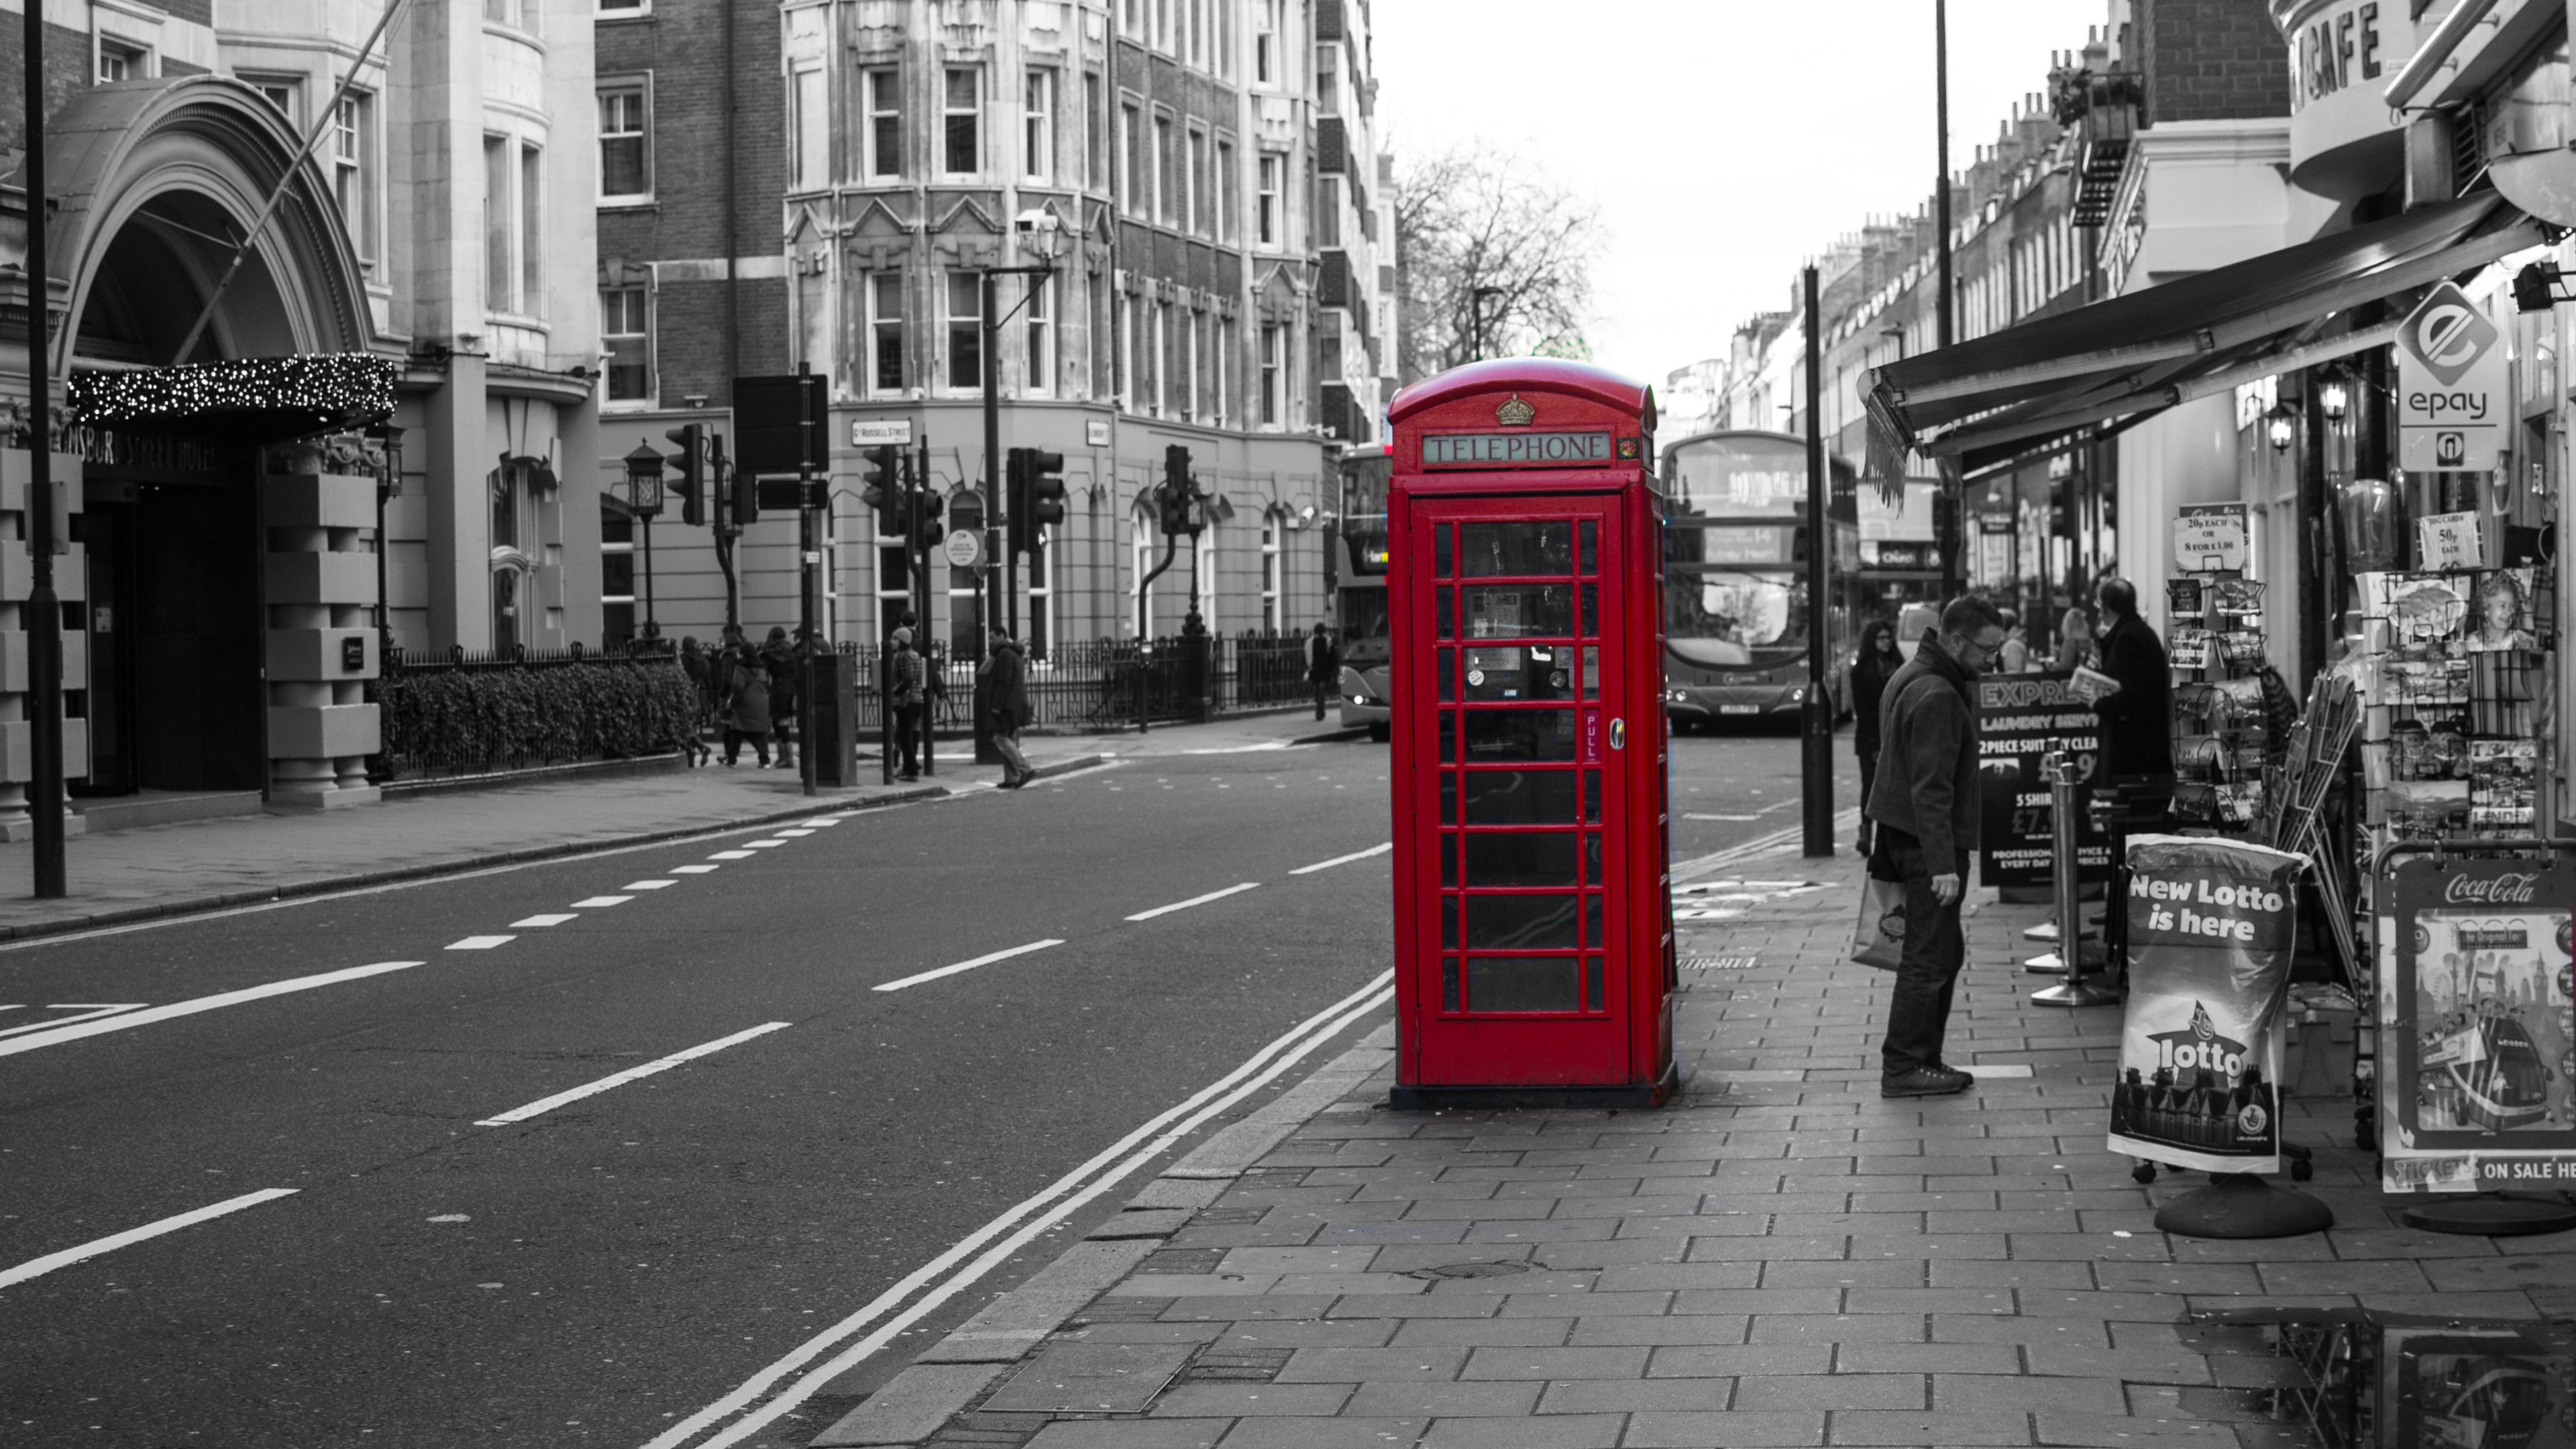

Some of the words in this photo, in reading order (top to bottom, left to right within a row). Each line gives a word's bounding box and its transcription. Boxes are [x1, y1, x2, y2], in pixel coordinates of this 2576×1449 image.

[2308, 1, 2381, 100] CAFE
[2409, 392, 2487, 419] epay
[64, 425, 119, 464] MSBUR
[888, 427, 911, 437] STREET
[1431, 436, 1603, 461] TELEPHONE
[2205, 519, 2227, 527] EACH
[2193, 543, 2210, 551] FOR
[1980, 680, 2092, 708] EXPRE
[1981, 715, 2053, 731] LAUNDRY
[2020, 739, 2045, 752] SUIT
[2012, 808, 2053, 834] £7.
[1992, 849, 2053, 859] PROFESSION
[2000, 860, 2030, 869] EVERY
[2032, 858, 2051, 868] DAY
[2130, 874, 2192, 902] New
[2198, 879, 2284, 912] Lotto
[2445, 873, 2539, 903] Coca-Cola
[2149, 903, 2174, 931] is
[2180, 908, 2255, 941] here
[2477, 928, 2508, 944] Original
[2160, 1038, 2243, 1079] lotto
[2484, 1163, 2508, 1179] ON
[2514, 1163, 2553, 1179] SALE
